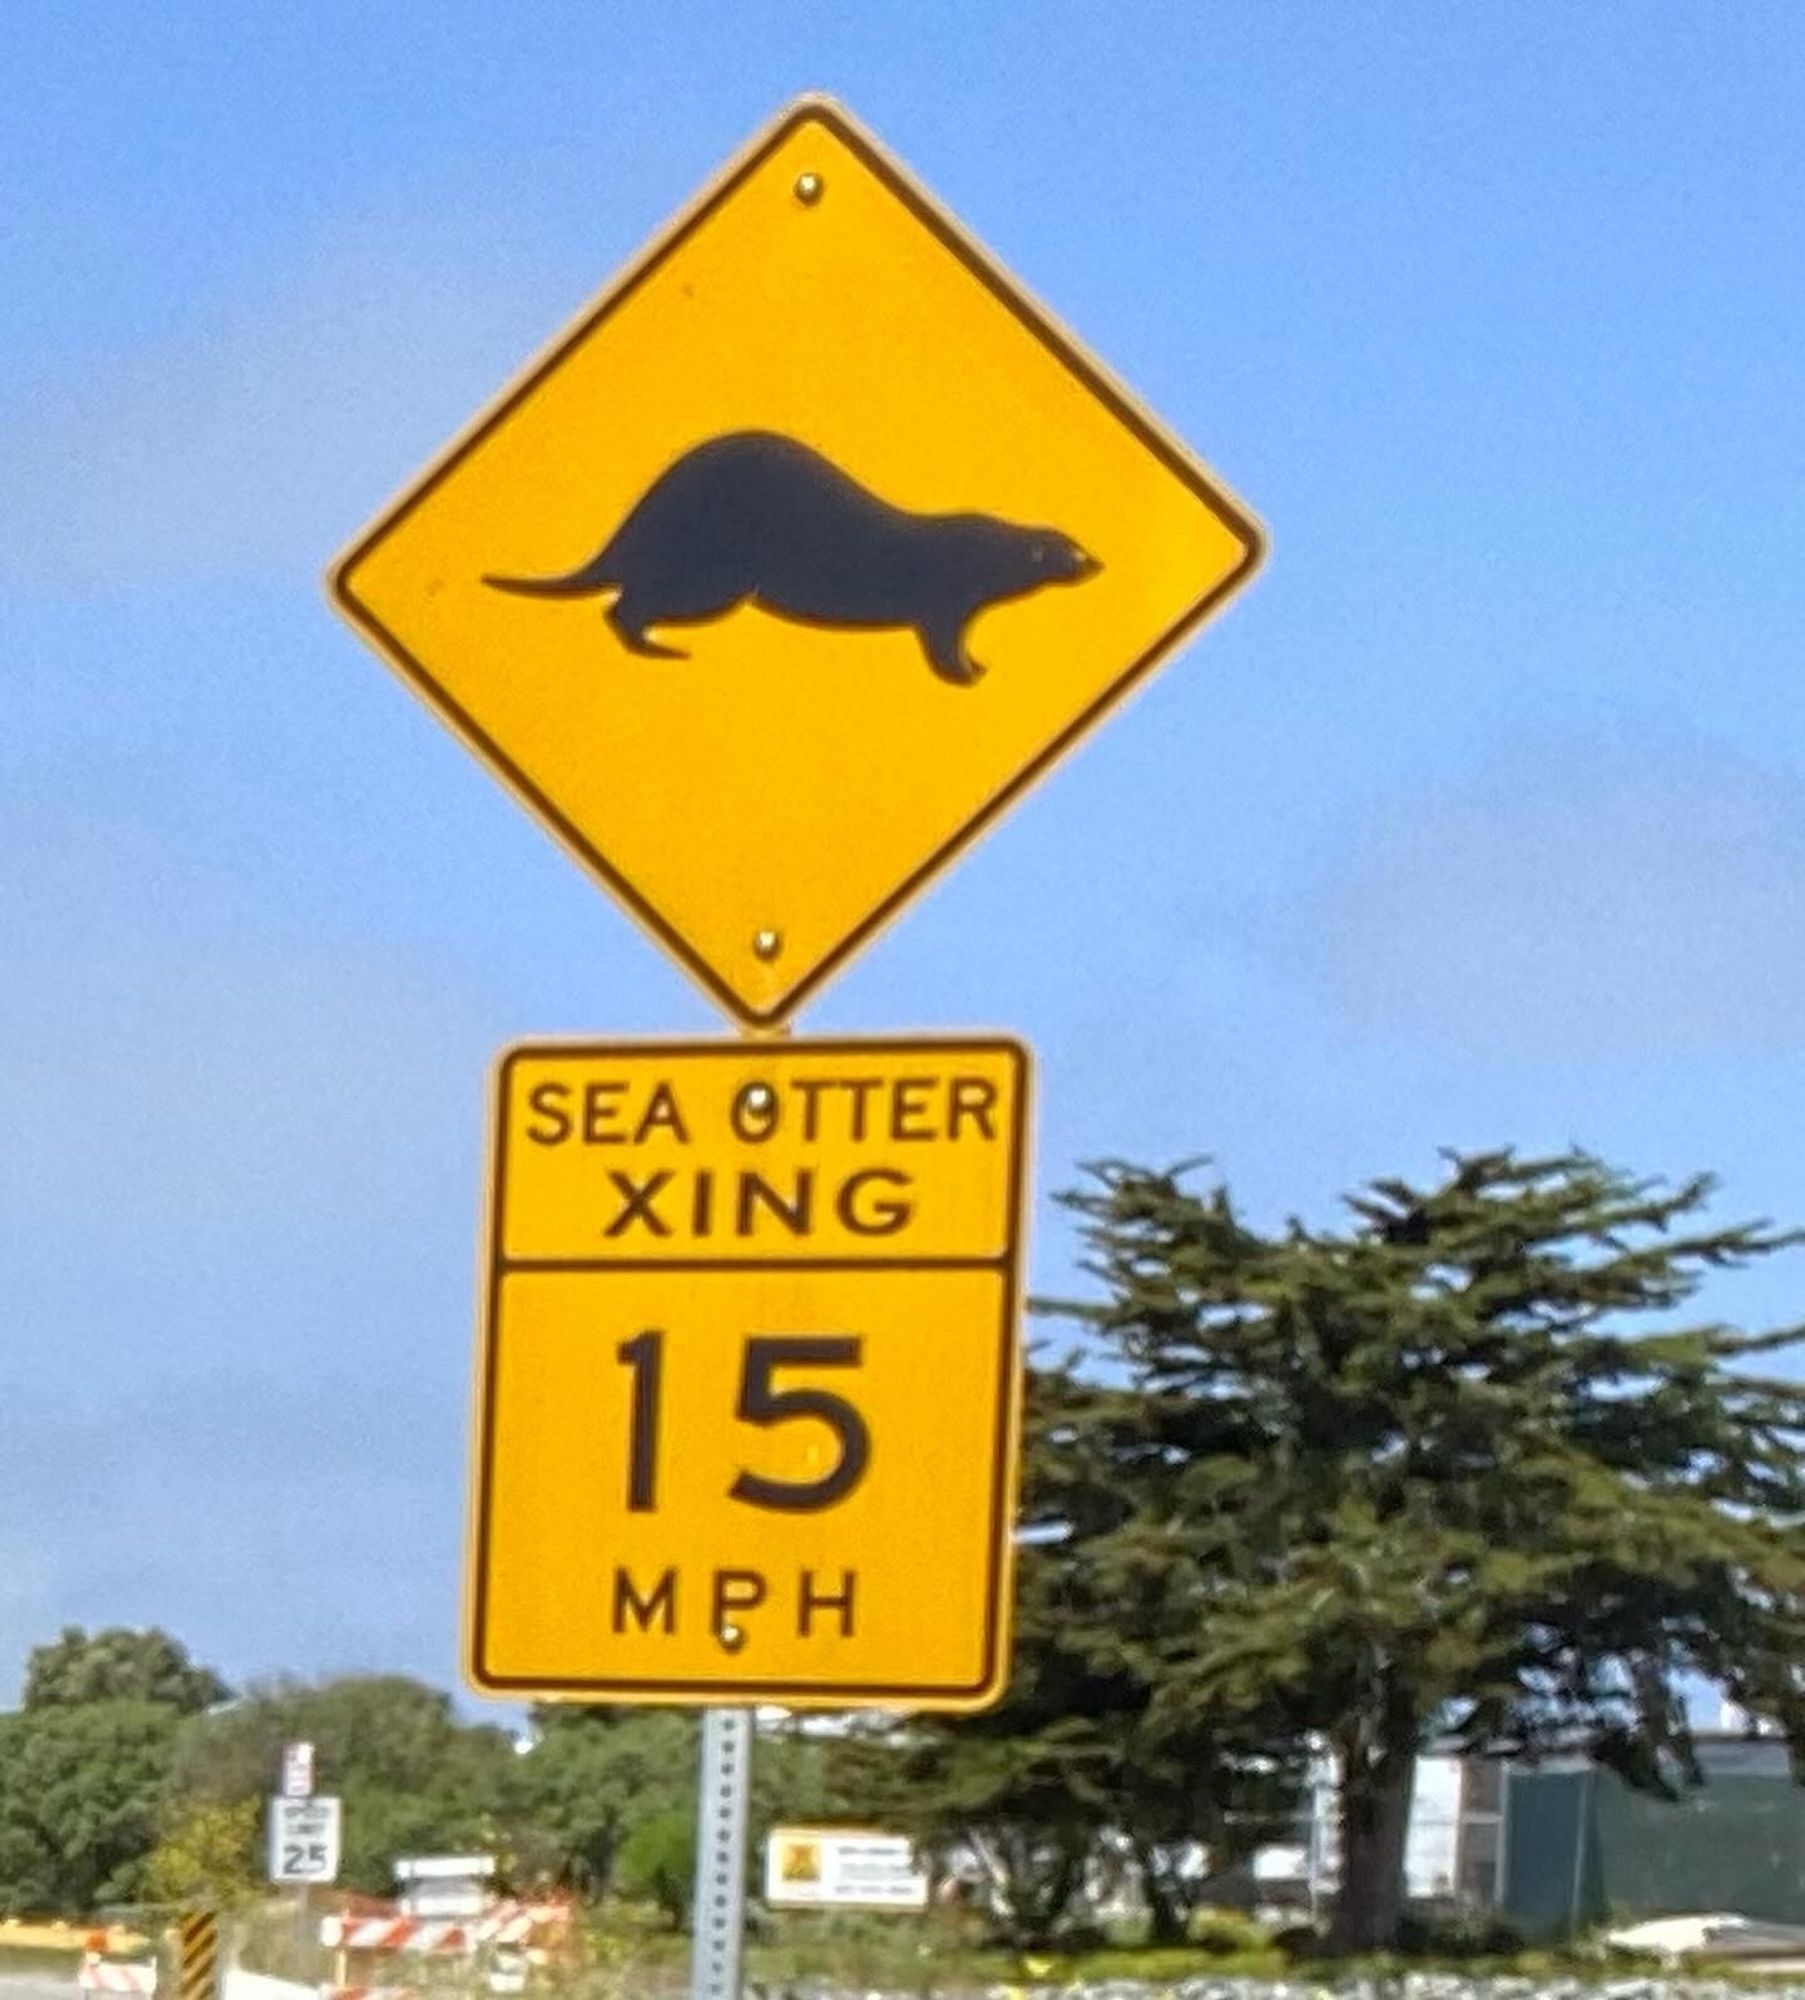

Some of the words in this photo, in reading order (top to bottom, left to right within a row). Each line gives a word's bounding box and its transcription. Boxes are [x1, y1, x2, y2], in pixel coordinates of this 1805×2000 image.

[527, 1081, 688, 1146] SEA
[732, 1077, 998, 1143] OTTER
[604, 1167, 914, 1239] XING
[618, 1330, 872, 1514] 15
[611, 1567, 857, 1638] MPH
[283, 1843, 328, 1875] 25
